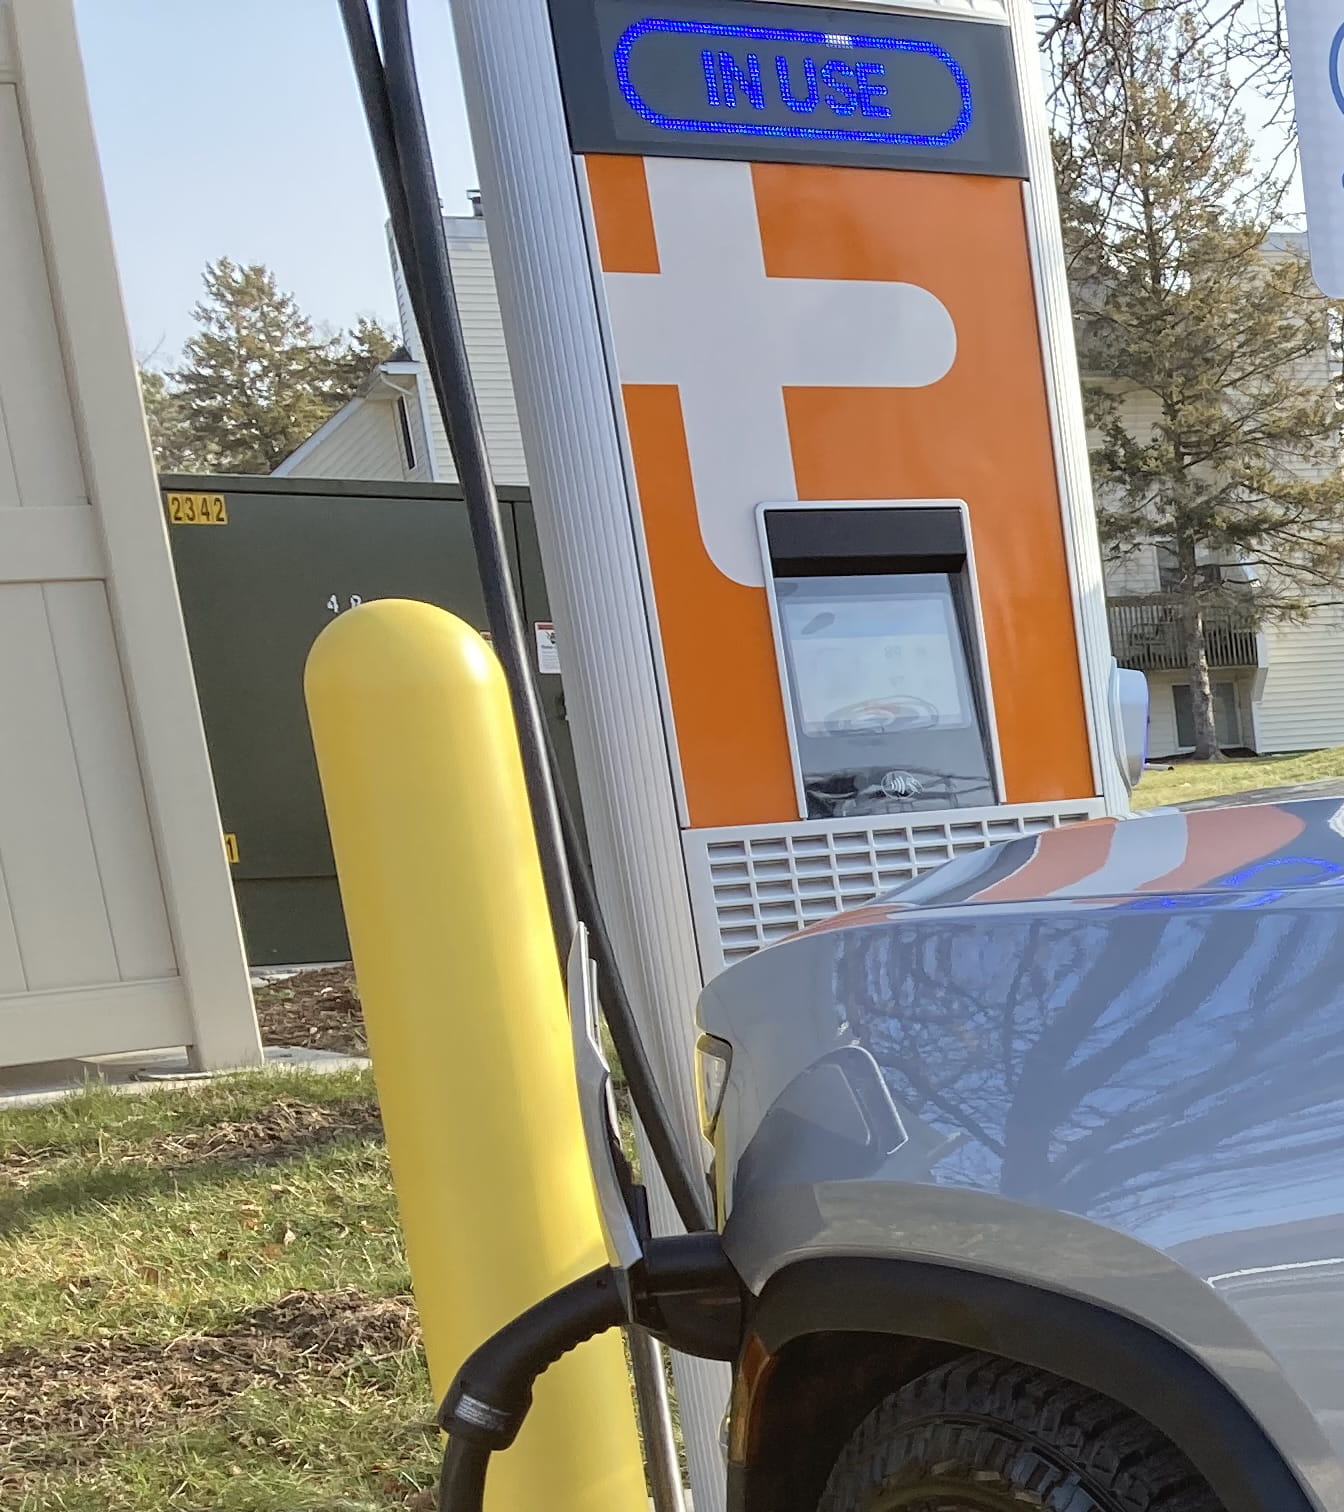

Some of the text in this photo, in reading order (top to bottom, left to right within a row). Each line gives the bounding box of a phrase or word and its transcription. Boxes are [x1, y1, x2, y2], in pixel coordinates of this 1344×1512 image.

[701, 49, 892, 118] IN USE
[170, 496, 225, 522] 2342
